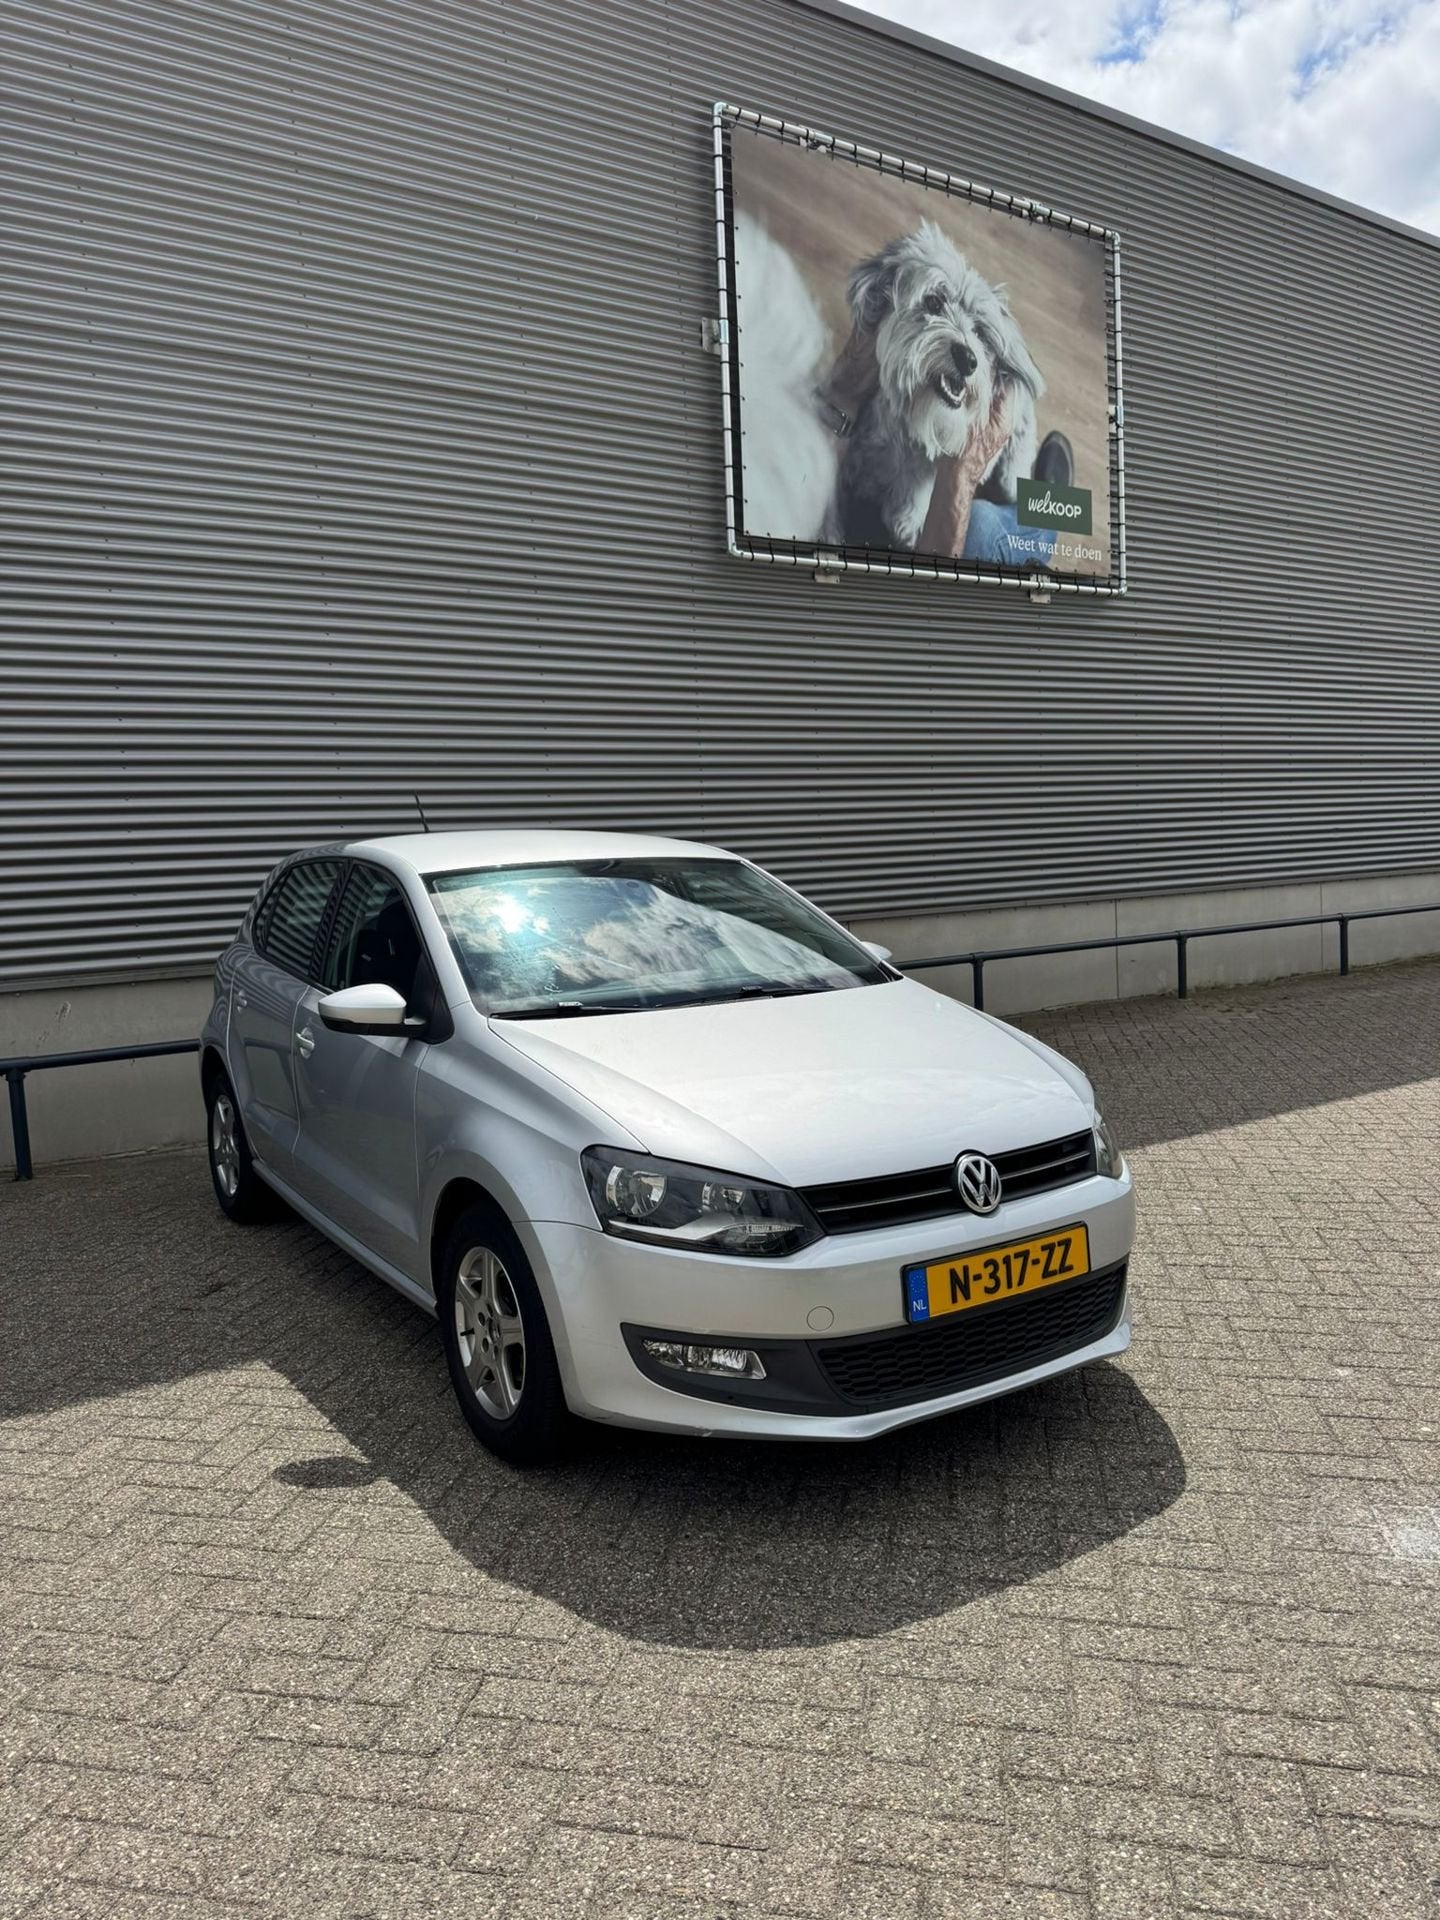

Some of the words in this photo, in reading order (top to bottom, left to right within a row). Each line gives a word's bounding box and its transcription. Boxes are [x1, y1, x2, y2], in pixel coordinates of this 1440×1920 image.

[1028, 490, 1082, 518] welKOOP
[1007, 534, 1036, 552] Weet
[1039, 541, 1058, 555] wat
[1061, 543, 1073, 557] te
[1074, 544, 1102, 561] doen
[912, 1299, 927, 1312] NL
[949, 1238, 1074, 1304] N-317-ZZ
